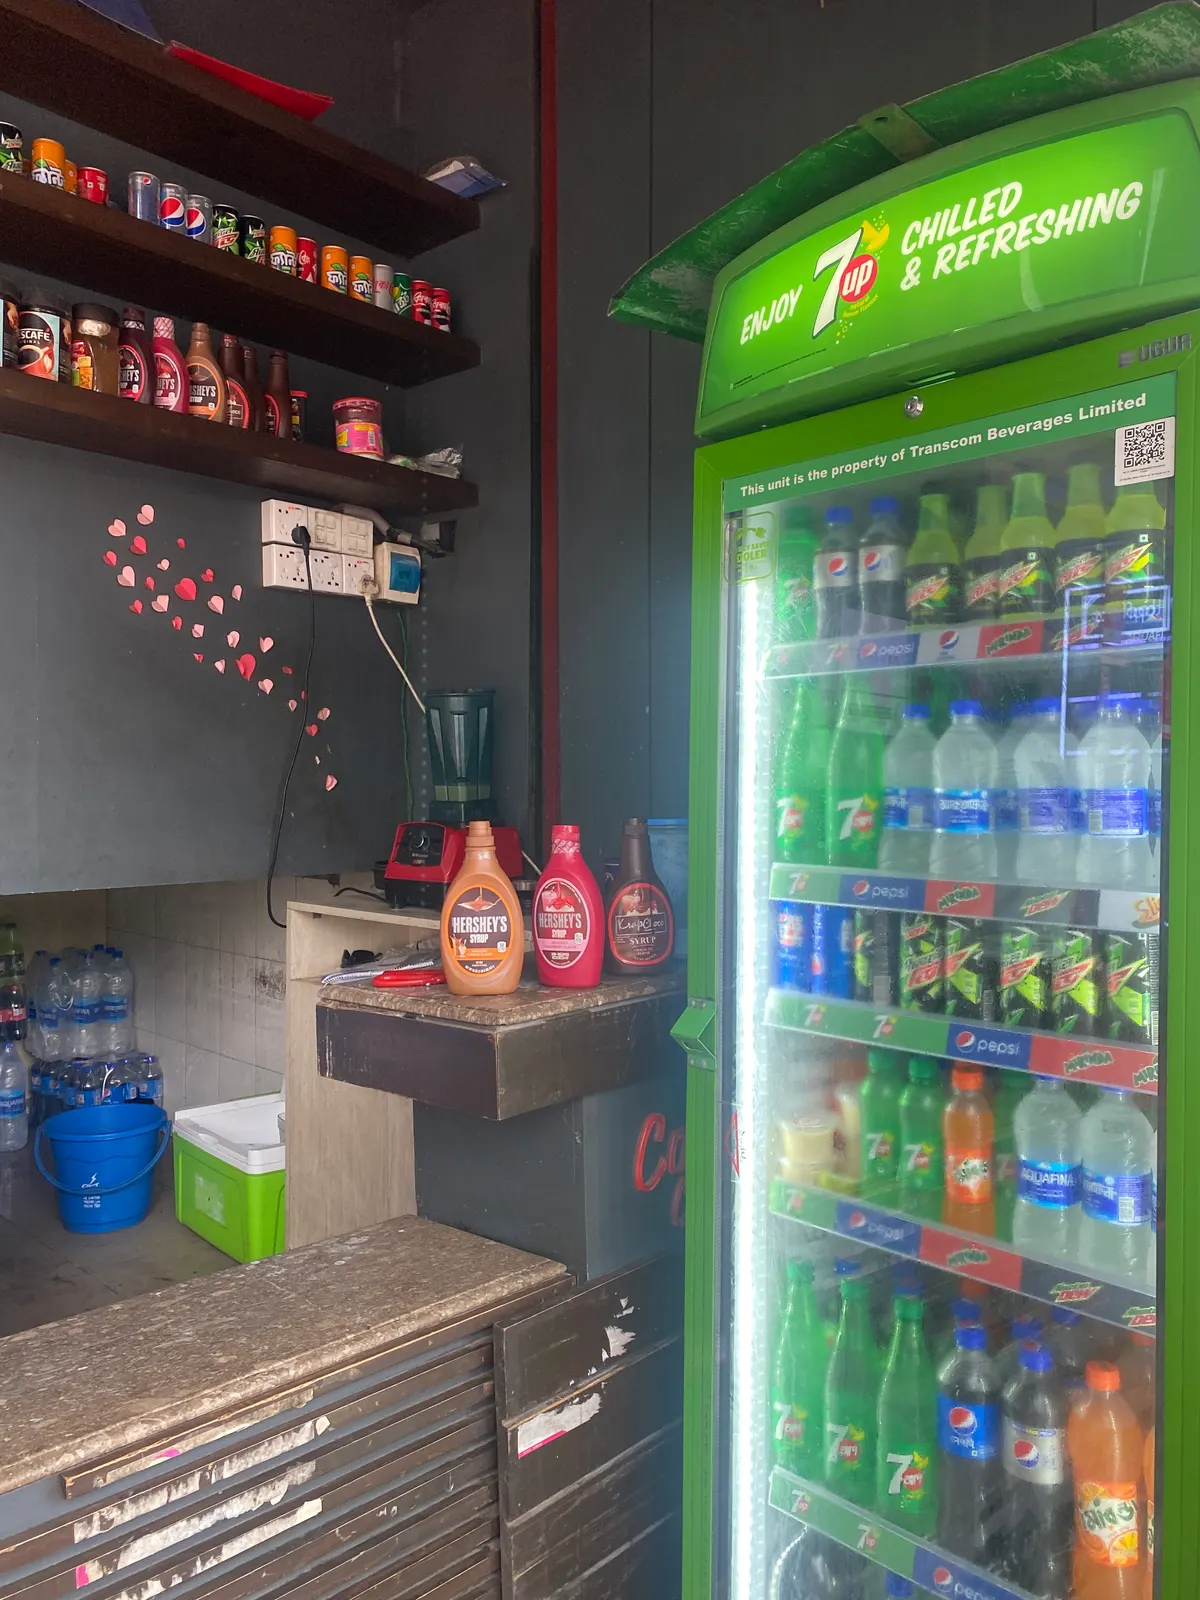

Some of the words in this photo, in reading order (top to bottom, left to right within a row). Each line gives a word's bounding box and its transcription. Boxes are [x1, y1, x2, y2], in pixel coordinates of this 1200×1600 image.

[901, 181, 1023, 255] CHILLED
[900, 257, 922, 291] &
[932, 181, 1143, 280] REFRESHING
[740, 284, 803, 346] ENJOY
[119, 369, 140, 382] HEY'S
[189, 385, 217, 397] SHEY'S
[740, 486, 764, 497] This
[768, 476, 790, 491] unit
[794, 473, 804, 484] is
[807, 468, 828, 481] the
[831, 454, 888, 478] property
[891, 449, 906, 462] of
[909, 432, 983, 459] Transcom
[987, 412, 1073, 441] Beverages
[1079, 392, 1148, 420] Limited
[735, 548, 768, 563] OOLER
[878, 642, 914, 656] pepsi
[872, 885, 909, 900] pepsi
[452, 915, 508, 934] HERSHEY'S
[538, 912, 582, 929] HERSHEY'S
[469, 933, 489, 944] SYRUP
[551, 929, 567, 939] SYRUP
[629, 935, 657, 946] SYRUP
[976, 1038, 1020, 1057] pepsi
[1021, 1167, 1077, 1187] AQUAFINA
[867, 1221, 905, 1240] pepsi
